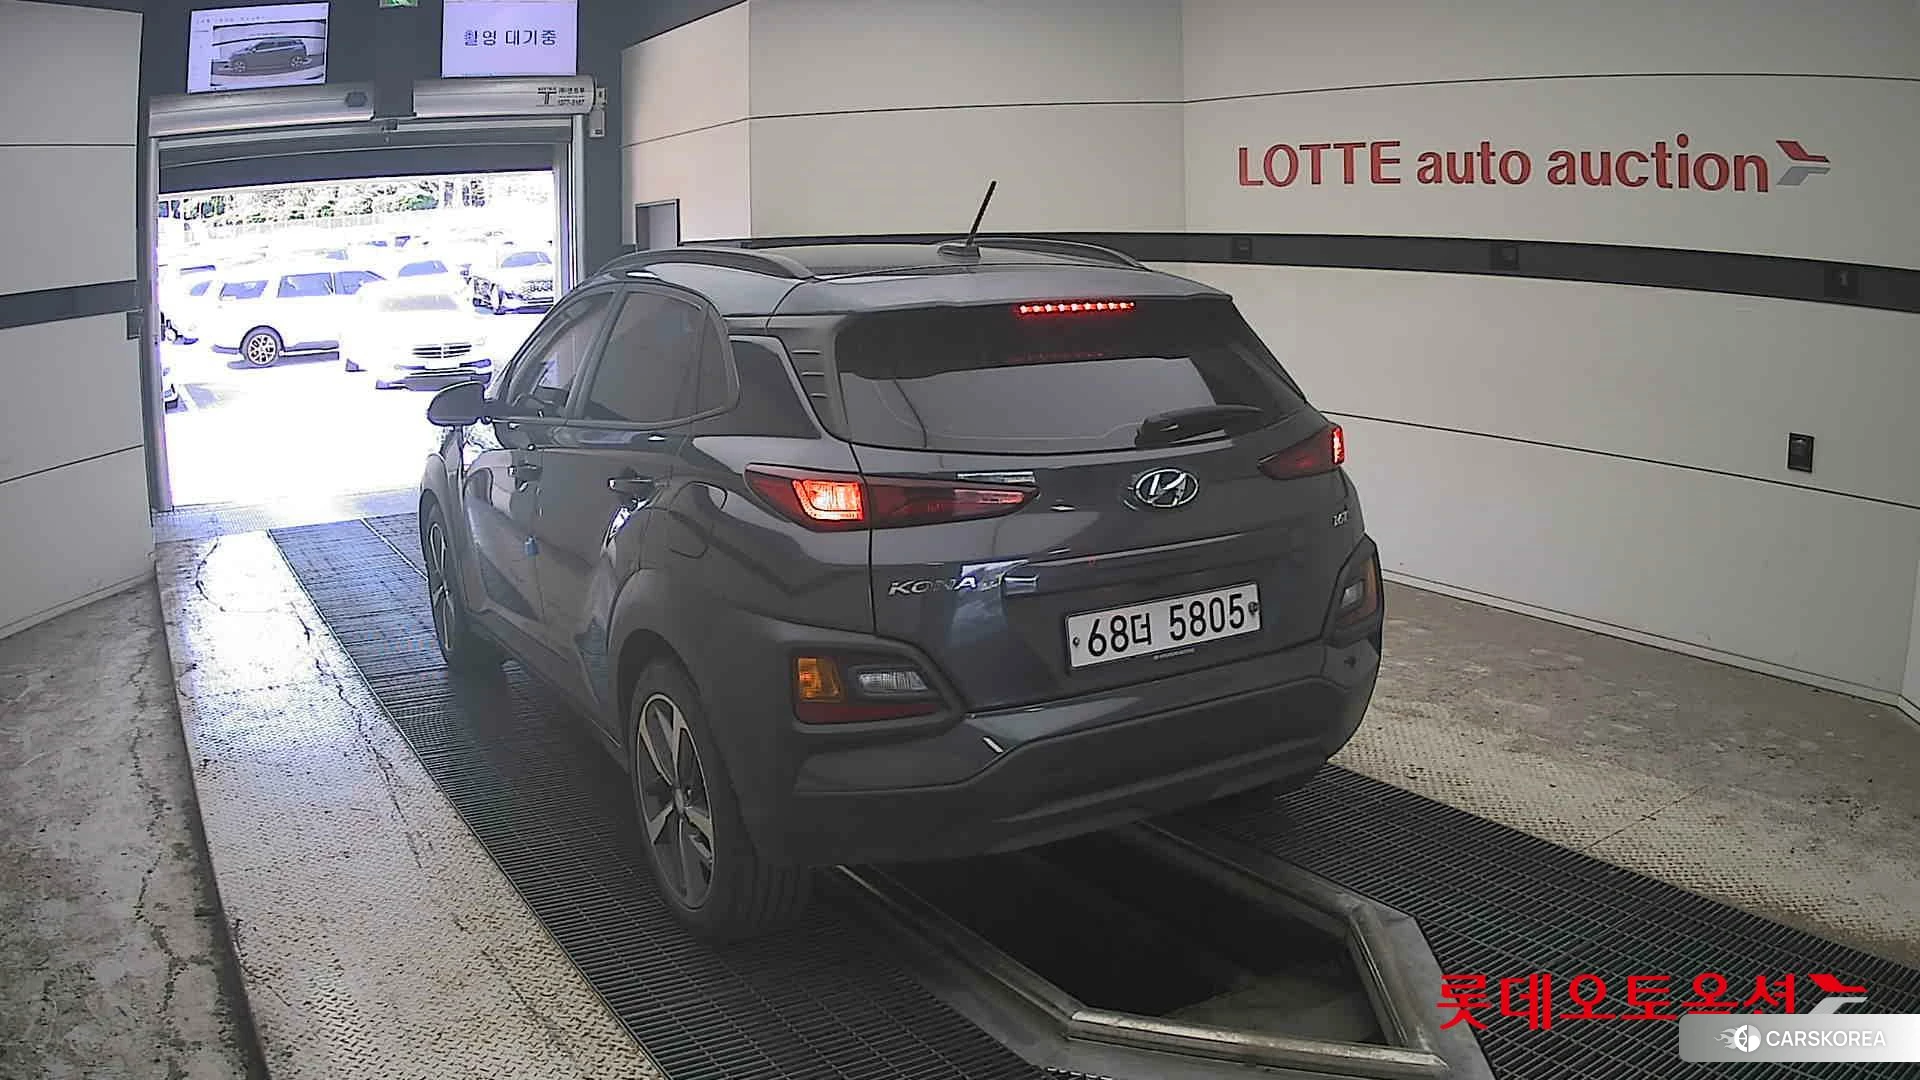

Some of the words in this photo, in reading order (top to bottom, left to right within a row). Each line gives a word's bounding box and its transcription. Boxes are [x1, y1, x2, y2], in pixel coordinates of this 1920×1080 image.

[505, 29, 557, 46] 대기중
[1238, 140, 1400, 187] LOTTE
[1416, 141, 1531, 186] auto
[1546, 133, 1769, 193] auction
[887, 574, 977, 596] KONA
[1087, 611, 1152, 657] 68더
[1169, 593, 1245, 641] 5805
